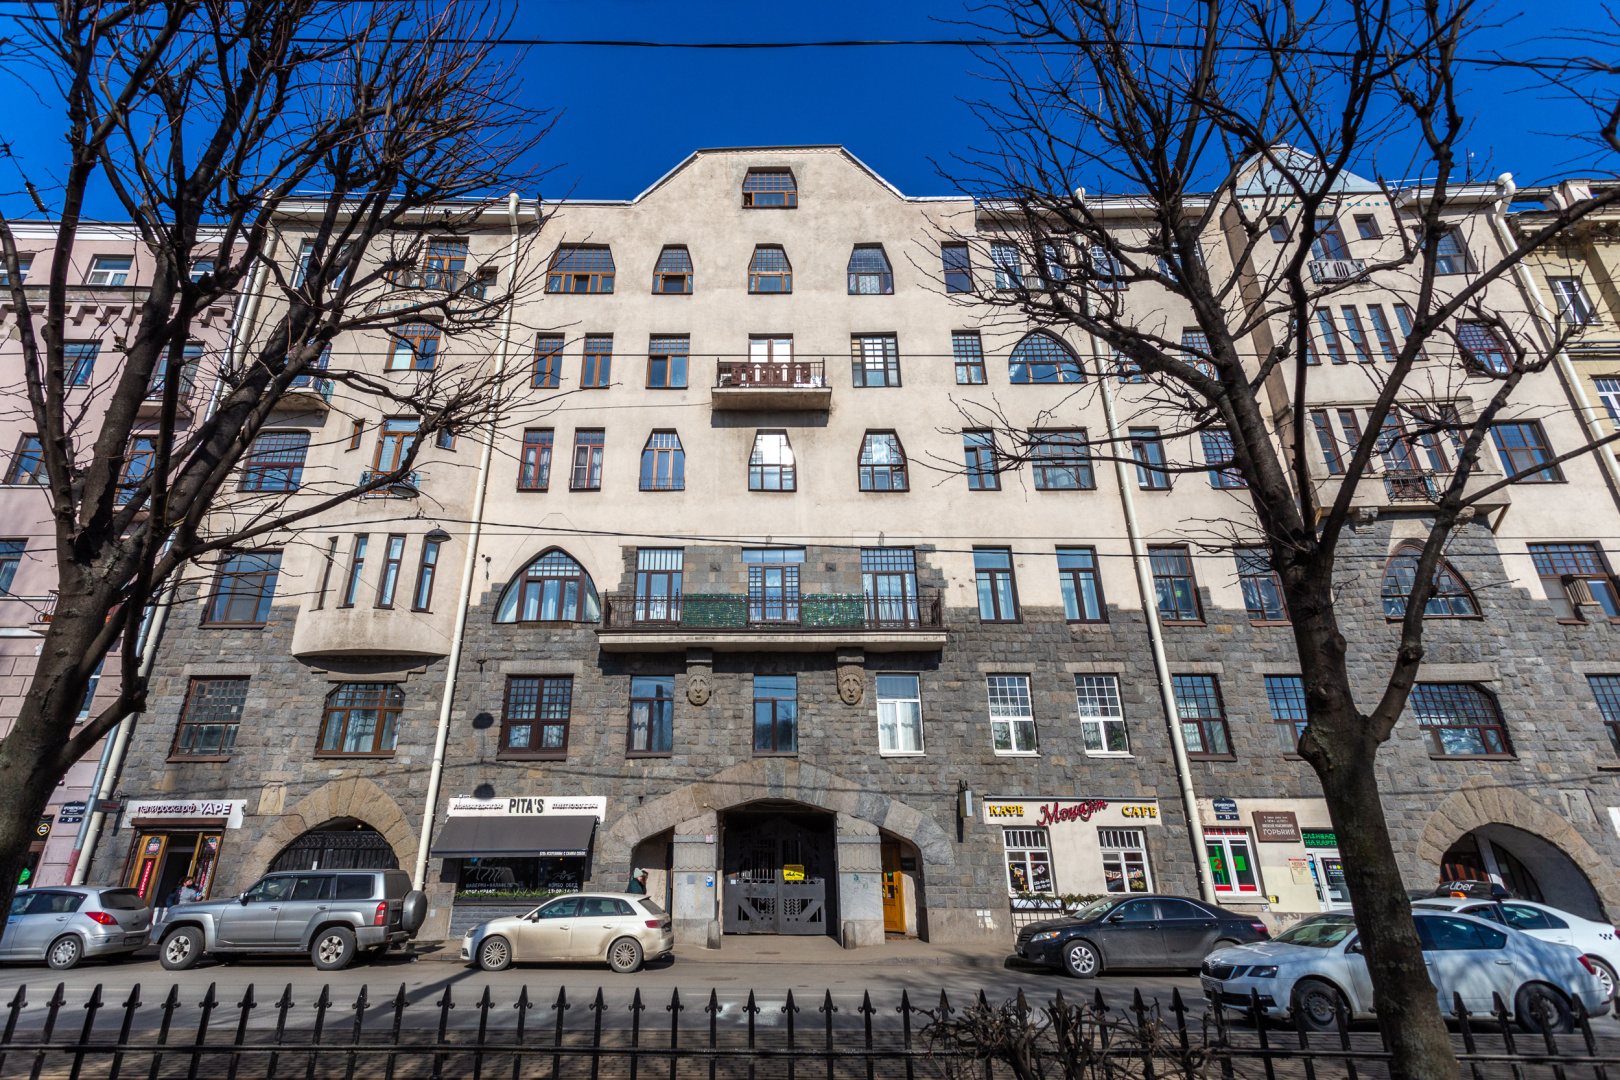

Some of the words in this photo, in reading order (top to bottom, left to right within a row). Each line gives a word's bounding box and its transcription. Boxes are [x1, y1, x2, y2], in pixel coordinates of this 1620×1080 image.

[200, 803, 232, 815] VAPE
[508, 798, 545, 814] PITA'S
[989, 804, 1025, 817] КАФЕ
[1037, 798, 1108, 826] Моцарт
[1122, 805, 1159, 818] CAFE
[1449, 881, 1475, 891] Uber
